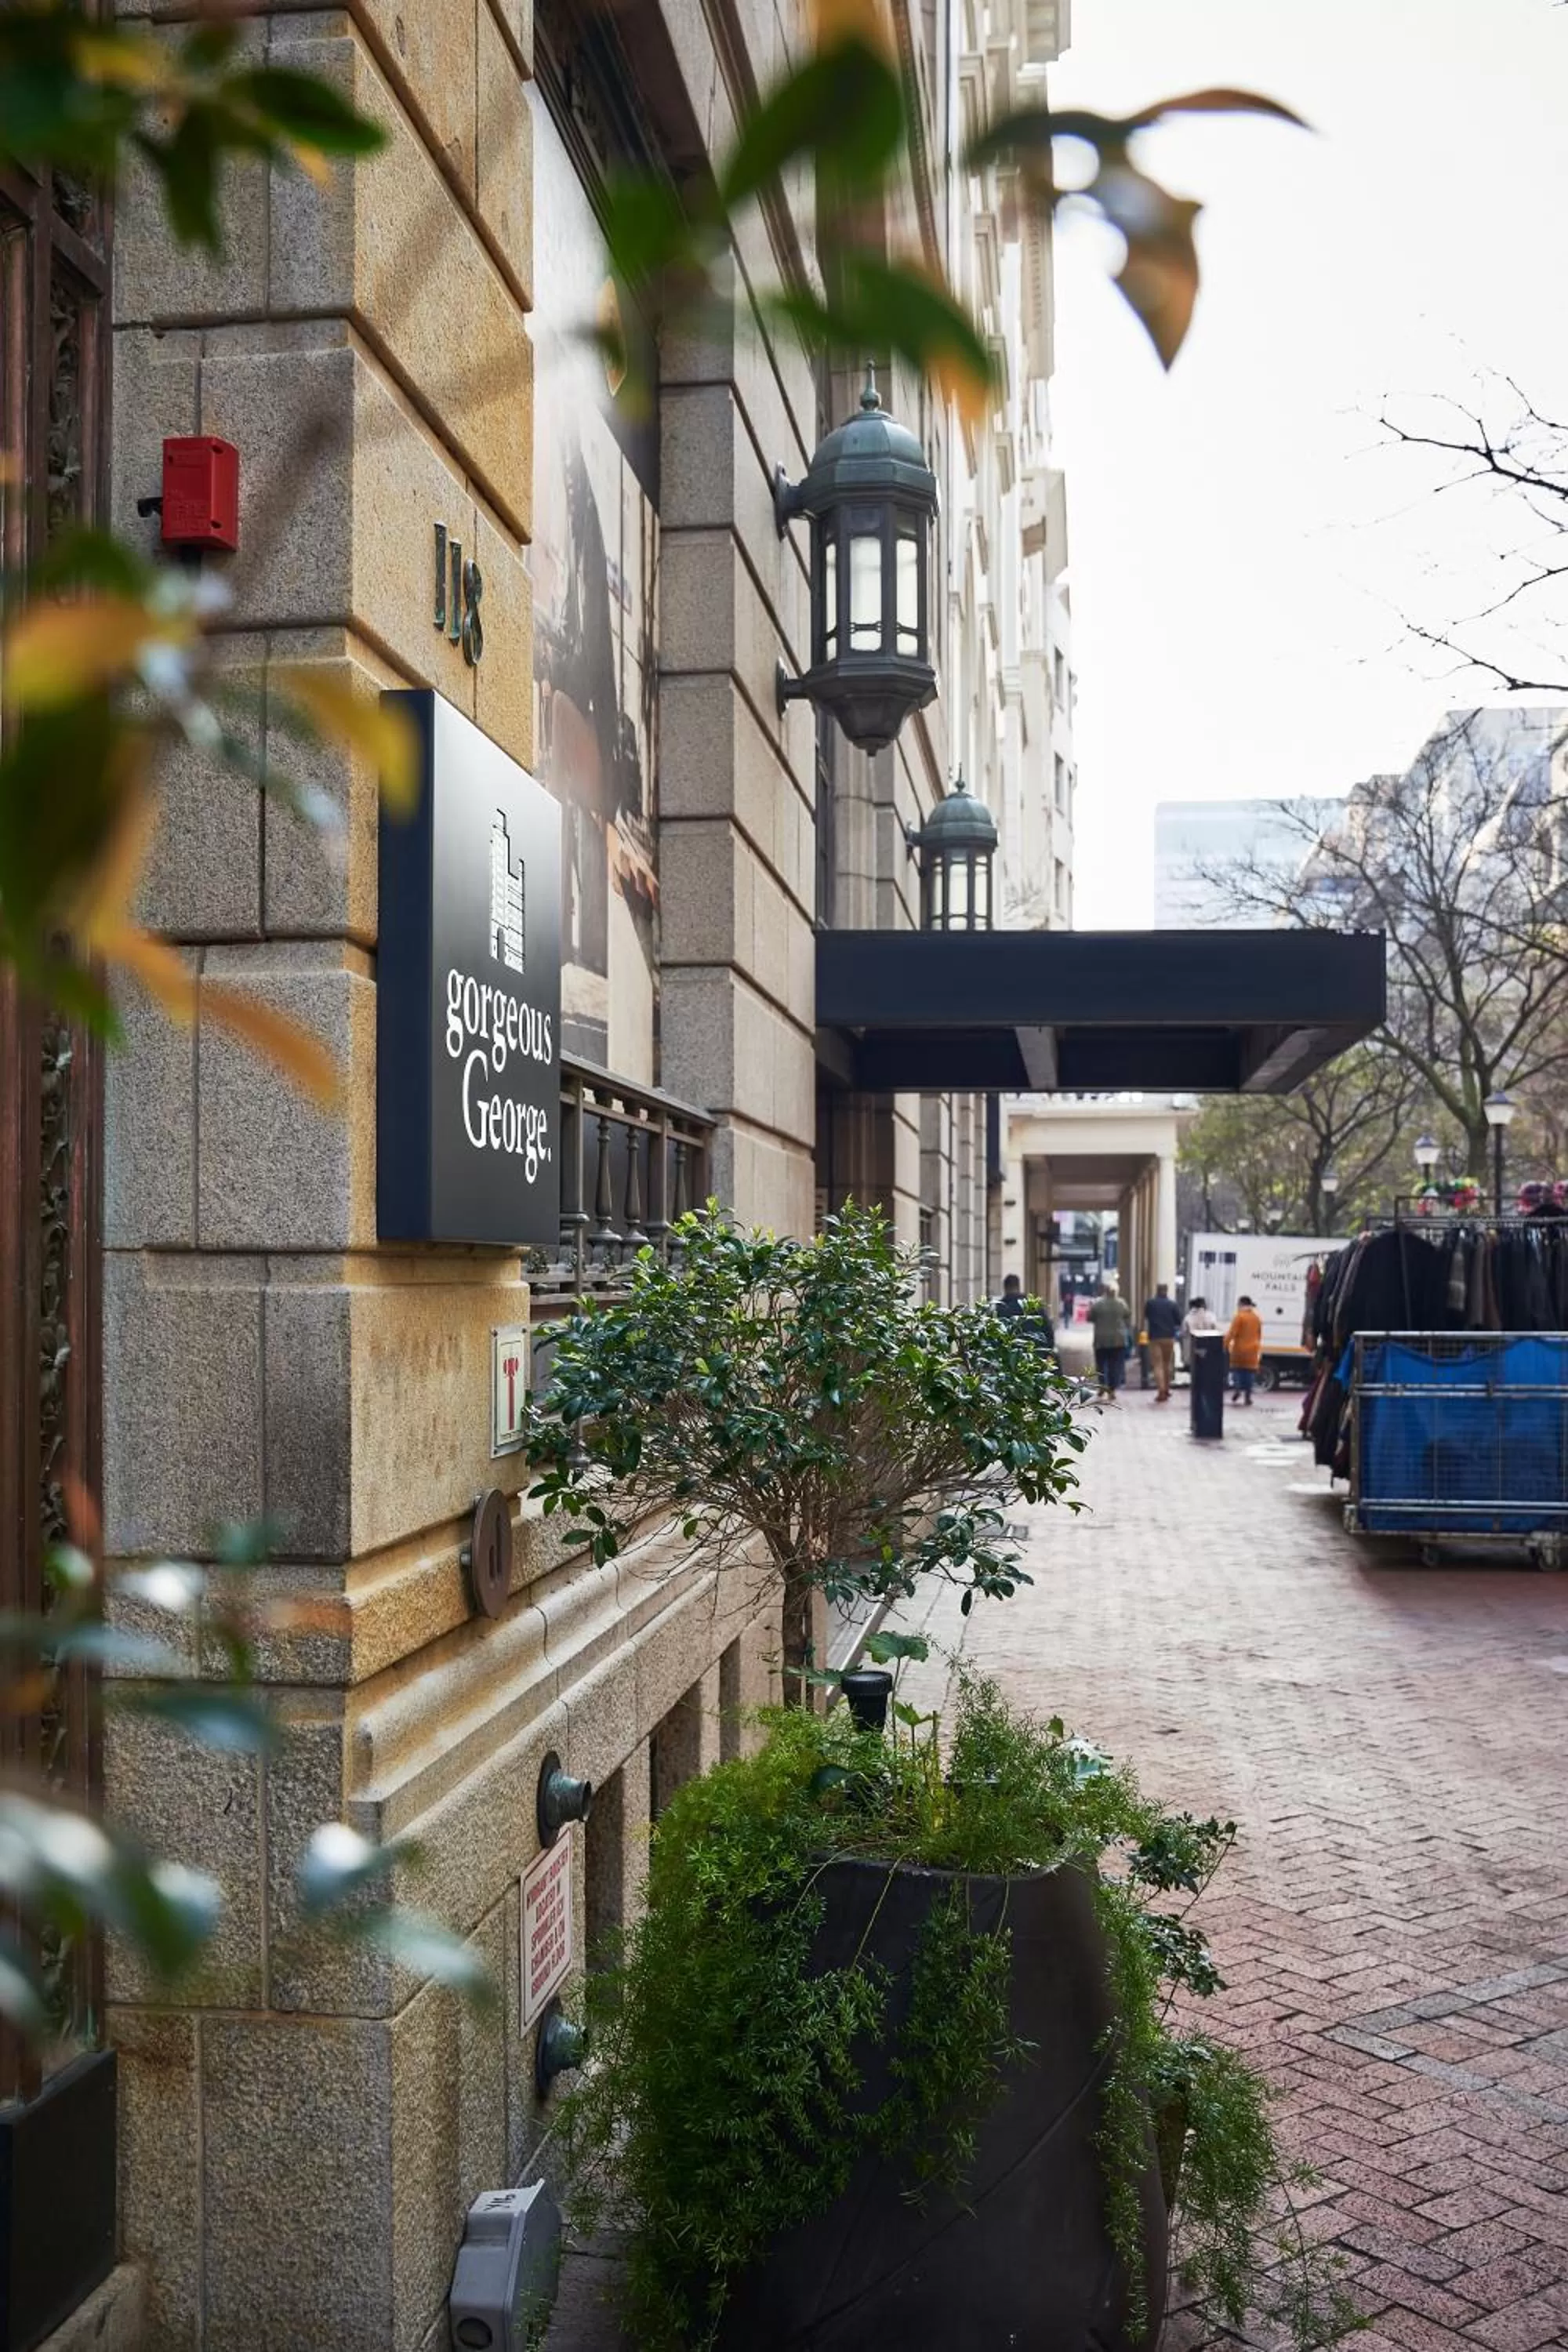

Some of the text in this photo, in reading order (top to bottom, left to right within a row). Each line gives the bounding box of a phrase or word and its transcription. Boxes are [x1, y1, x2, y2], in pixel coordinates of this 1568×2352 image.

[434, 521, 483, 667] 118
[446, 968, 552, 1073] gorgeous
[463, 1049, 551, 1184] George.
